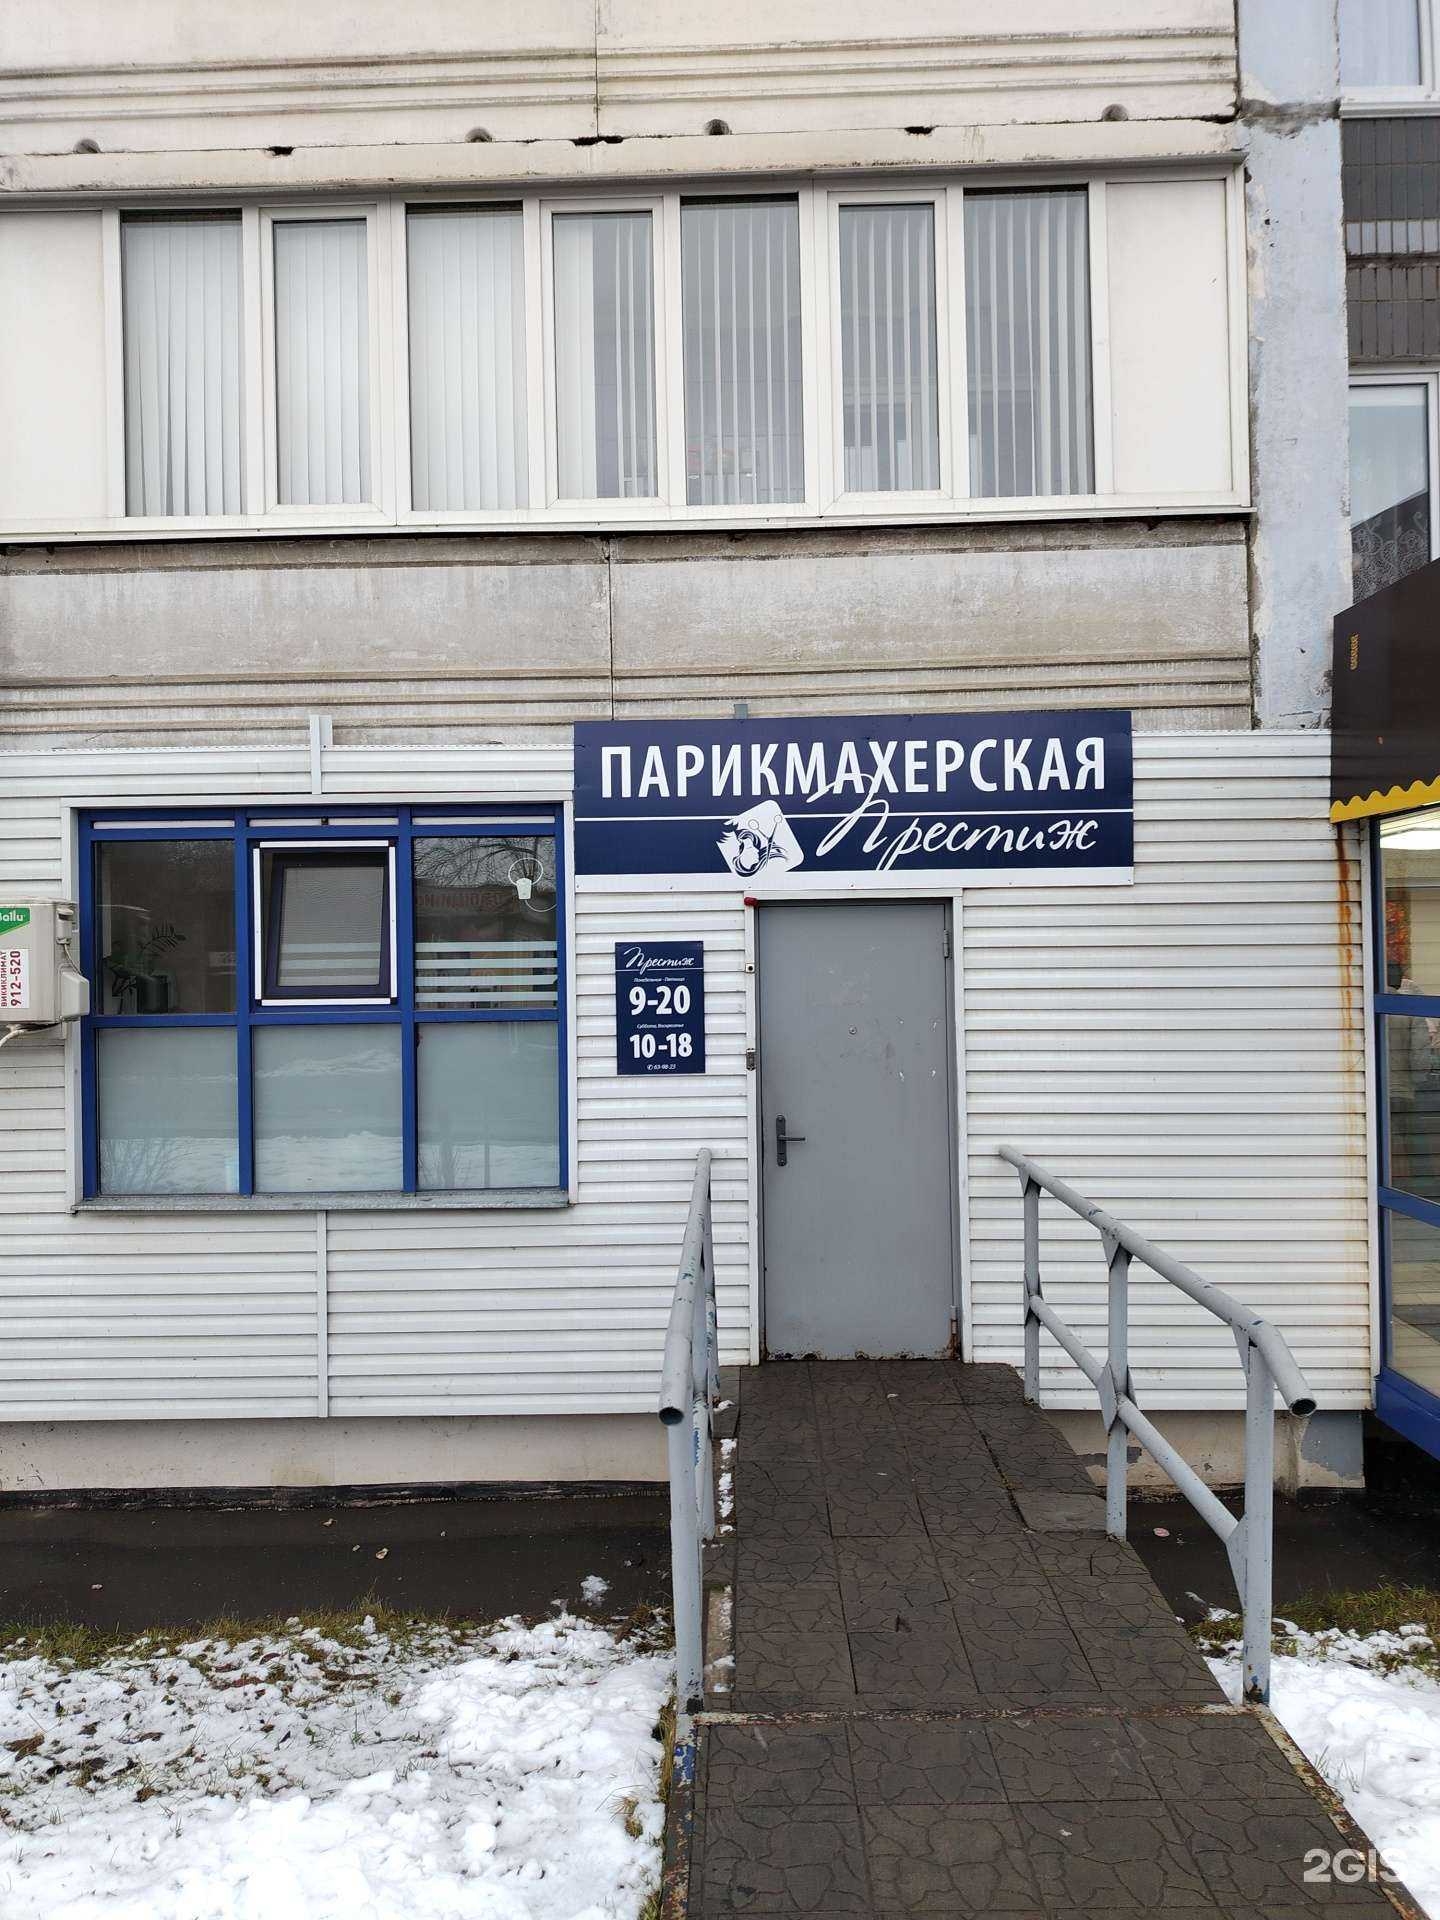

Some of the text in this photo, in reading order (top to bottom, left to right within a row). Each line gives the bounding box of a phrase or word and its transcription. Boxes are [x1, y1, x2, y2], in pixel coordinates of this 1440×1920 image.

[601, 738, 1105, 798] ПАРИКМАХЕРСКАЯ
[807, 773, 1098, 871] Престиж
[10, 950, 22, 1007] 912-520
[623, 946, 695, 975] Престиж
[629, 985, 691, 1015] 9-20
[629, 1033, 693, 1058] 10-18
